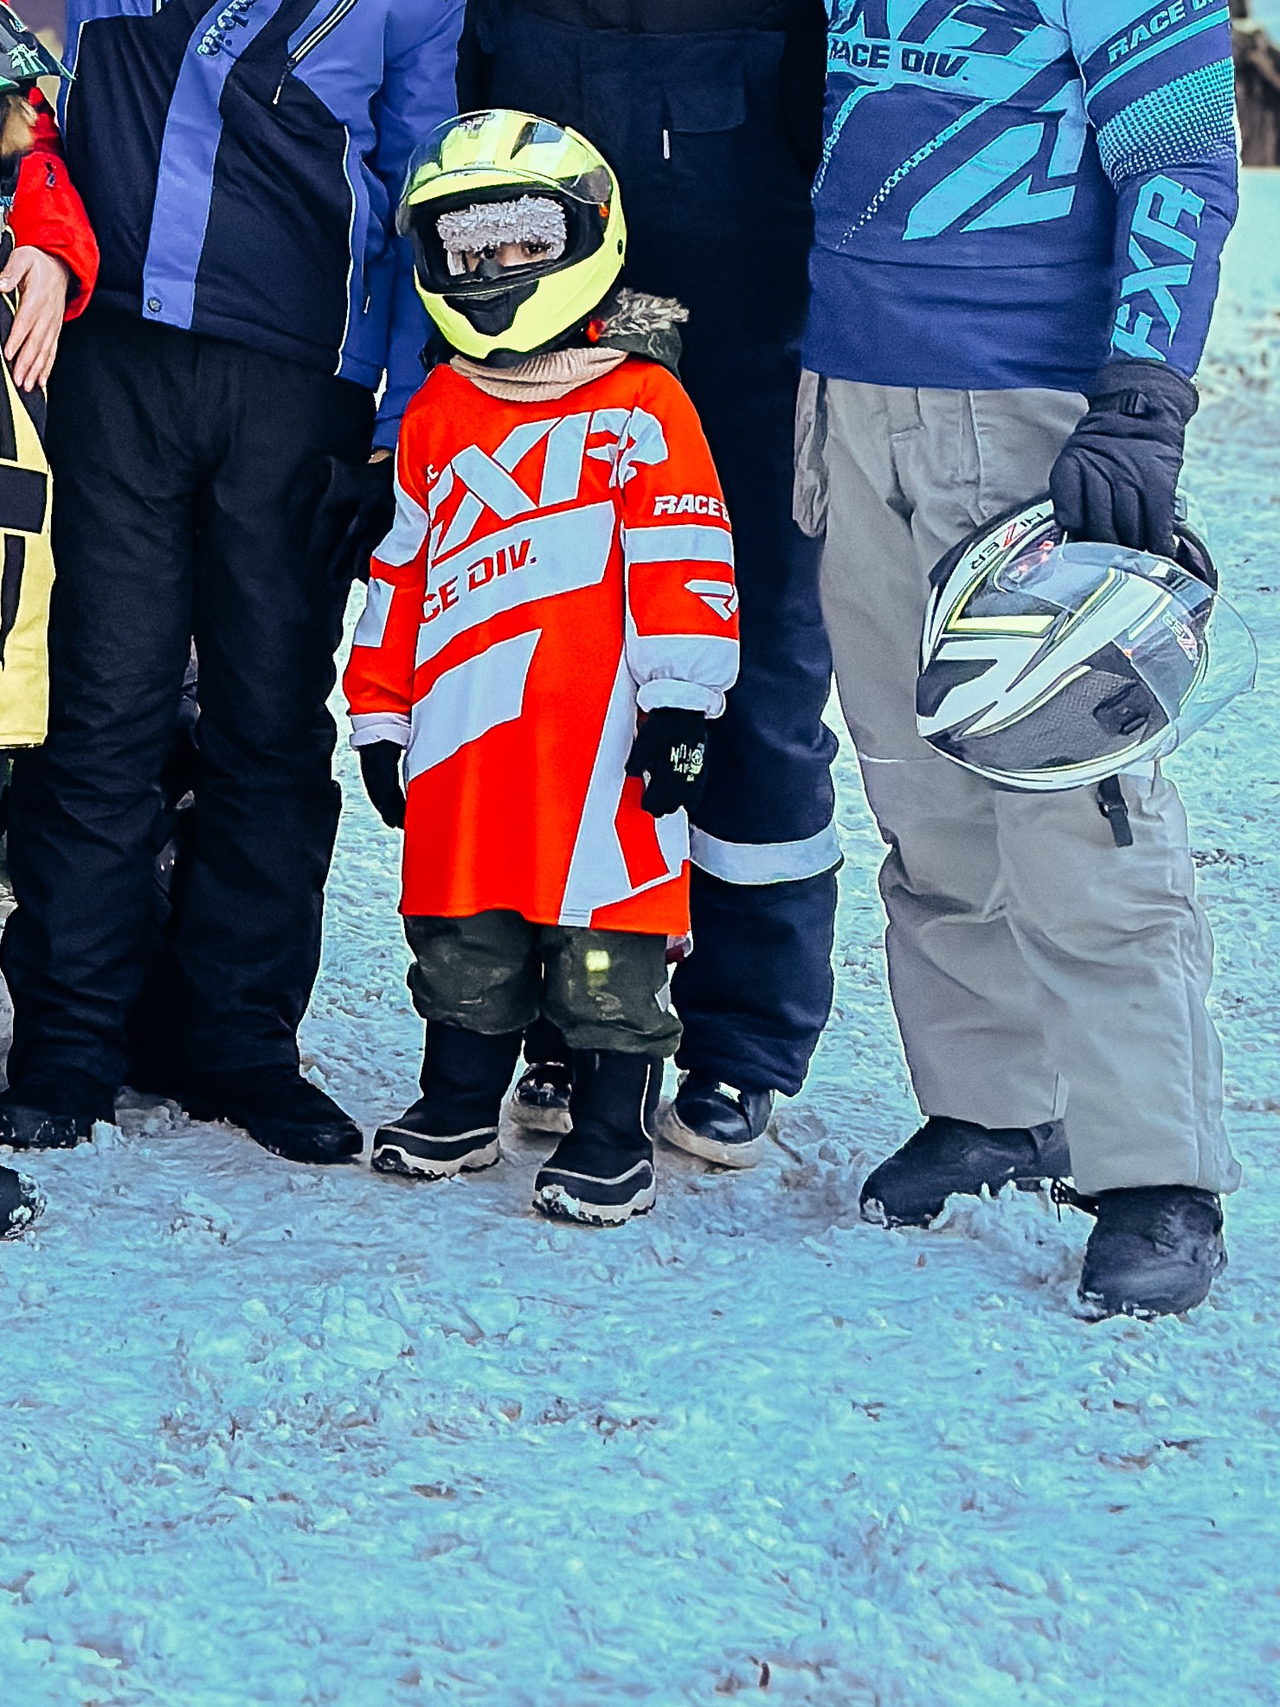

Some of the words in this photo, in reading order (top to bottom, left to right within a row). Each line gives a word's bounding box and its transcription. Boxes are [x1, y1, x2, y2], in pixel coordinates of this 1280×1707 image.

[901, 49, 970, 82] DIV.
[1110, 174, 1207, 361] FXR
[653, 493, 722, 518] RACE
[466, 538, 538, 593] DIV.
[971, 511, 1045, 571] HIZER
